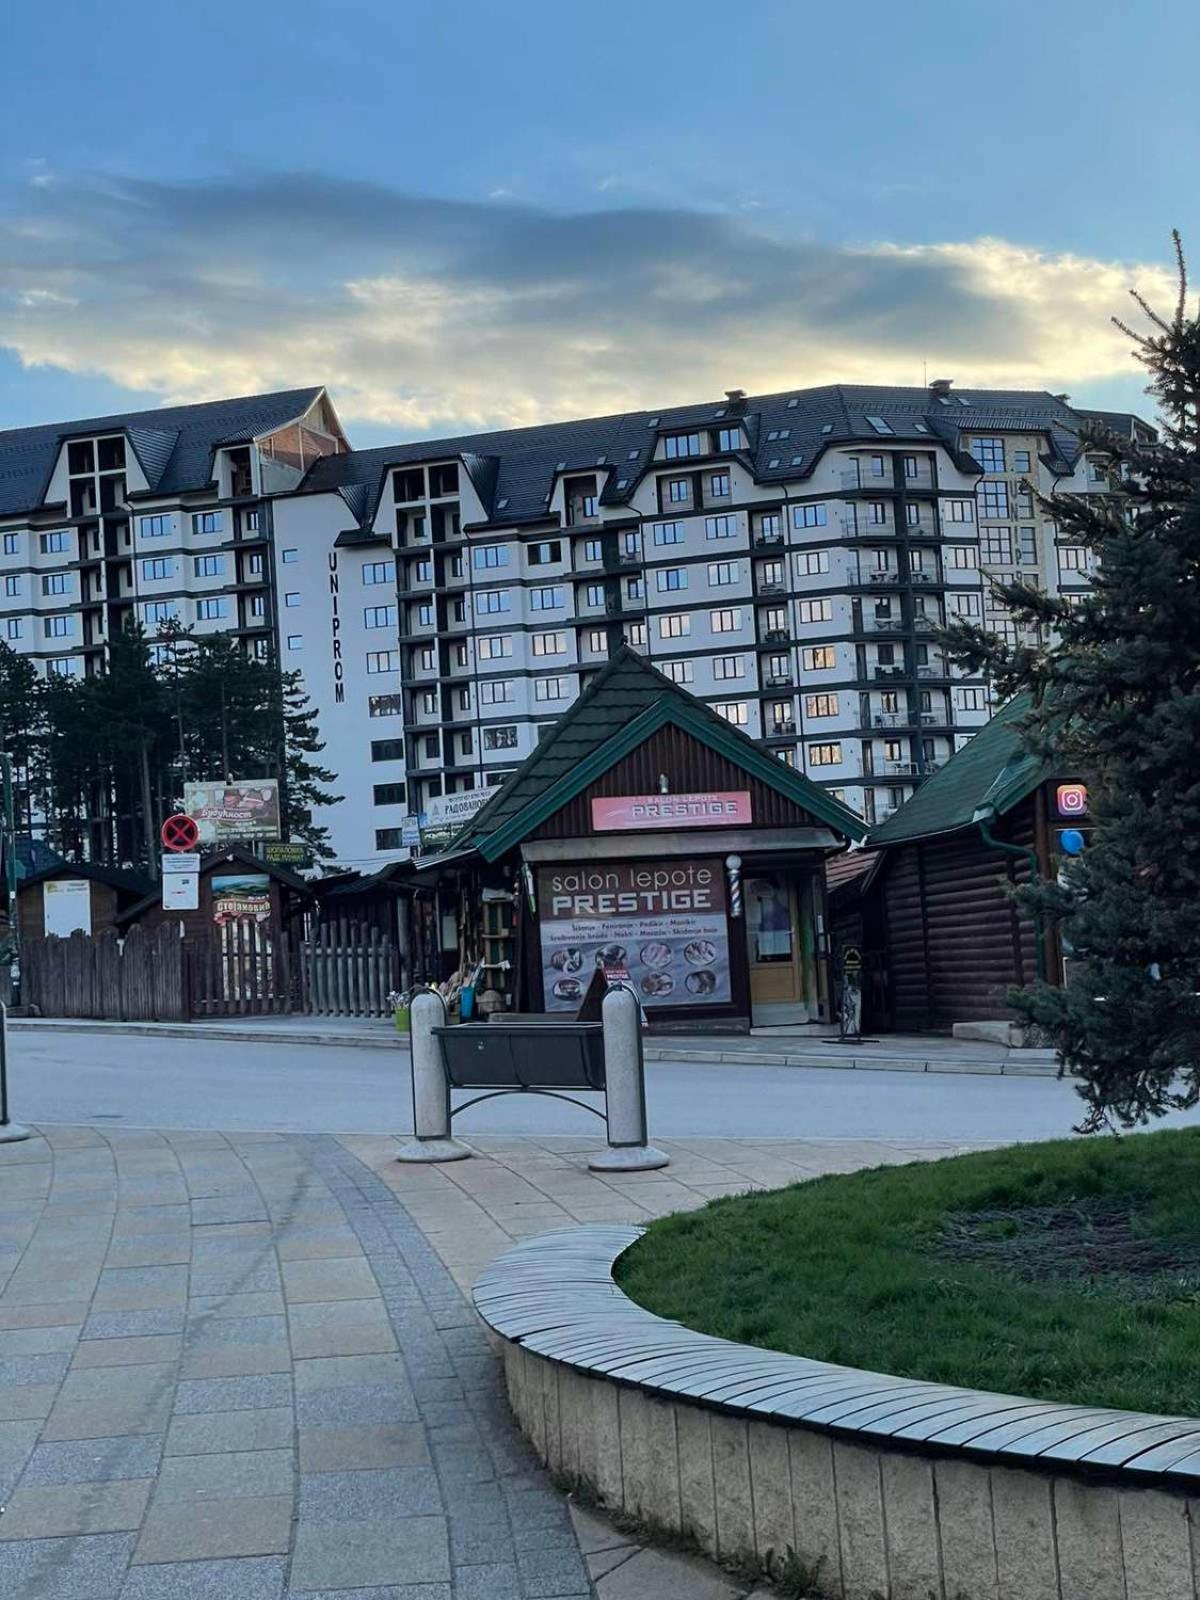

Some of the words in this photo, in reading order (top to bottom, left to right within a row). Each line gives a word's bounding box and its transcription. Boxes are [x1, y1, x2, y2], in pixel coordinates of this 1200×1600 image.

[328, 551, 344, 703] UNIPROM
[631, 800, 738, 817] PRESTIGE
[552, 871, 619, 892] salon
[630, 865, 712, 890] lepote
[552, 889, 711, 916] PRESTIGE
